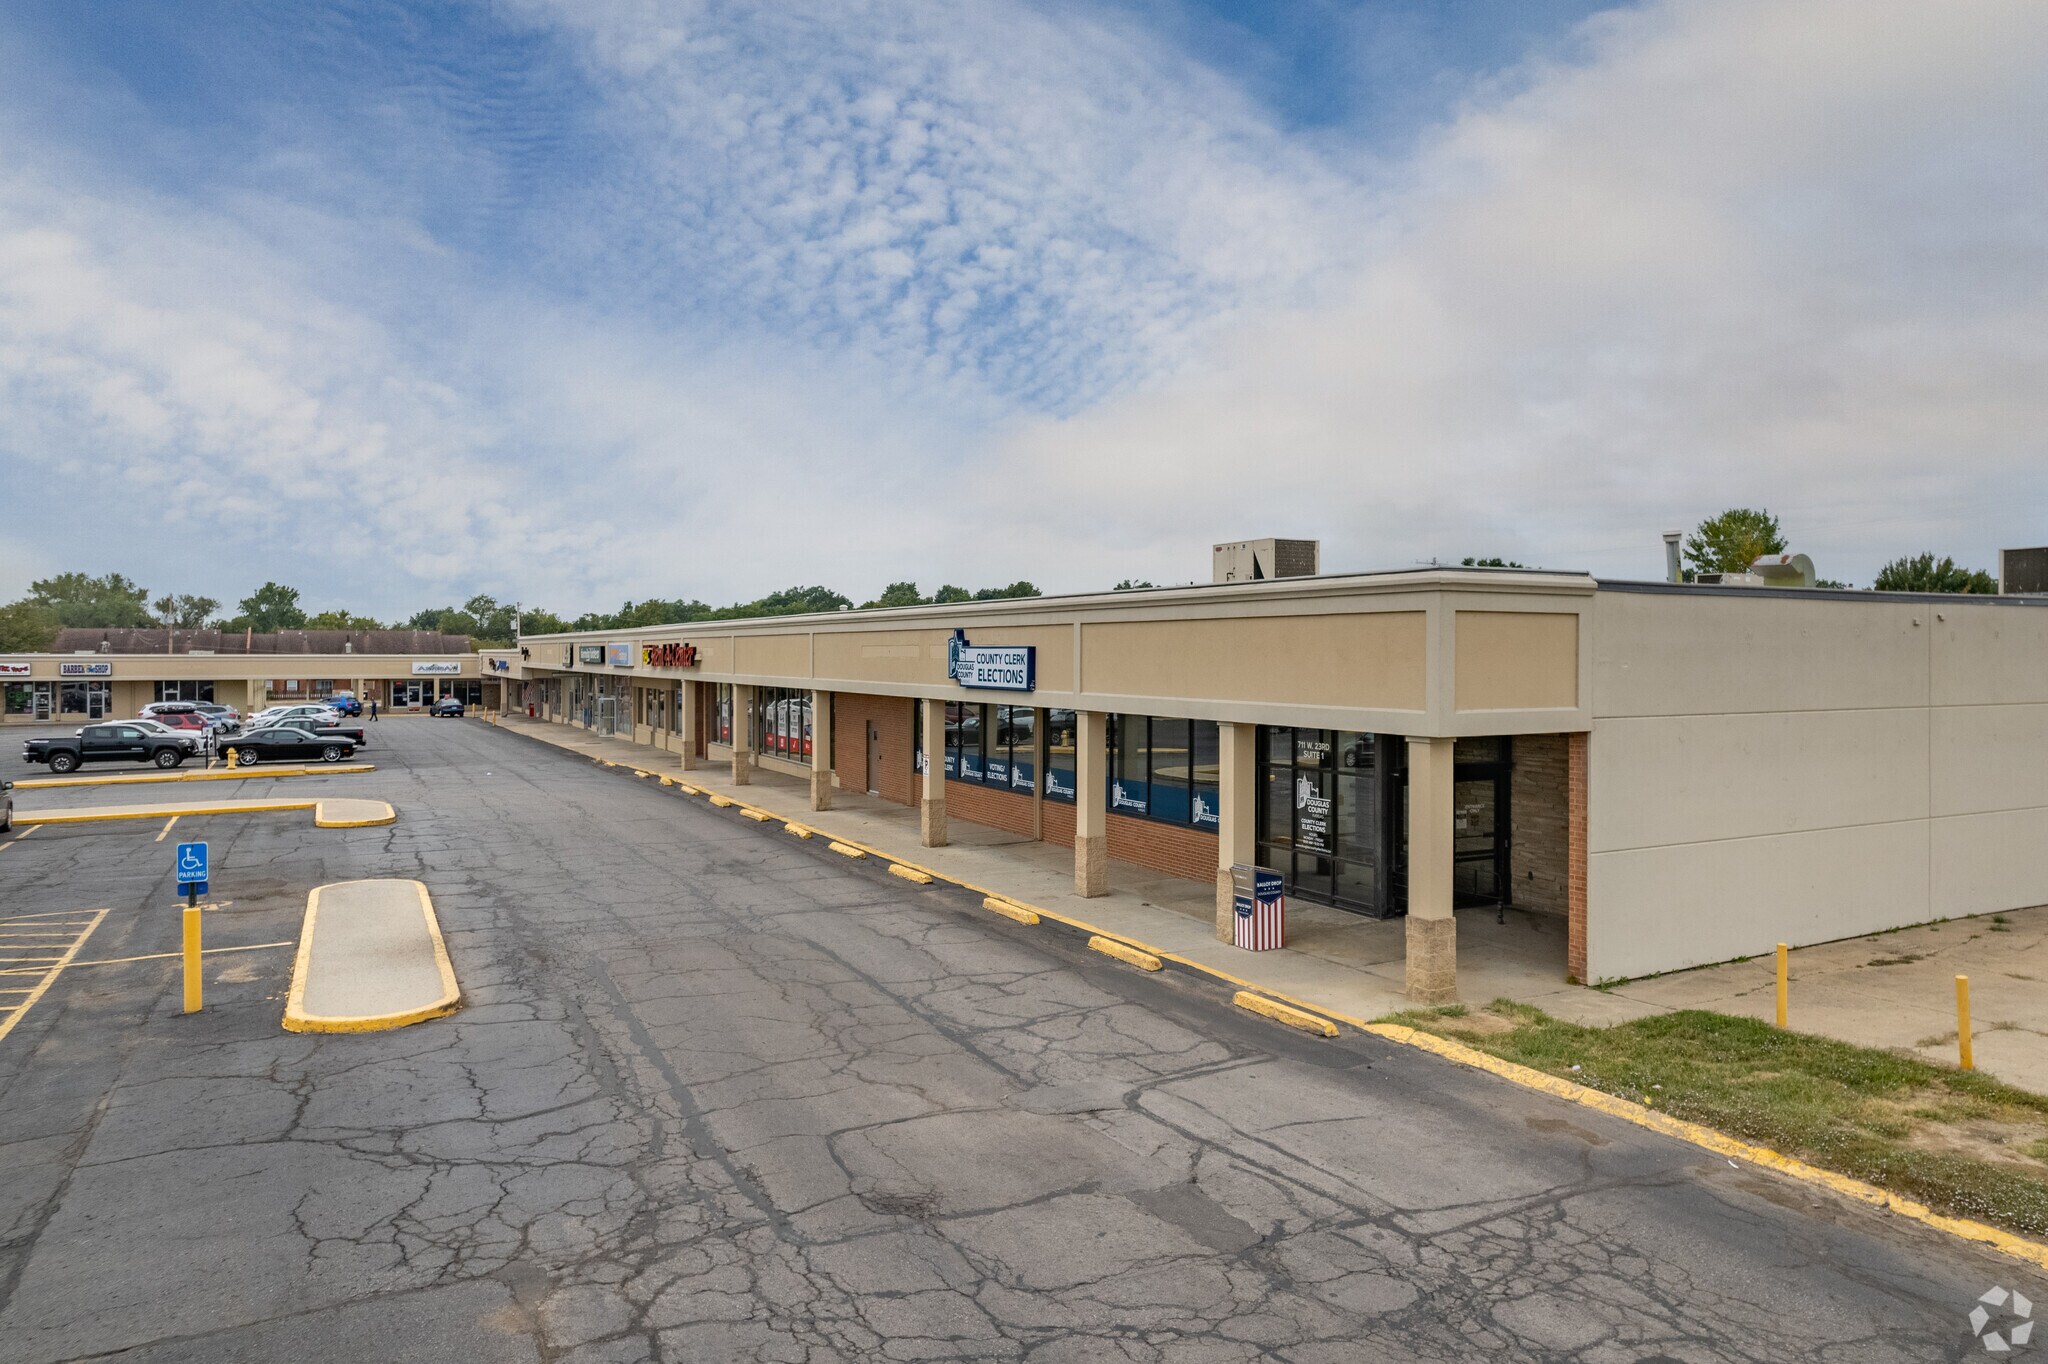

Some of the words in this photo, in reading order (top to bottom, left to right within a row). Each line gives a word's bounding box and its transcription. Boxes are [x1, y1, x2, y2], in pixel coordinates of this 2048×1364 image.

[976, 654, 1003, 664] COUNTY
[1004, 654, 1026, 665] CLERK
[978, 668, 1024, 684] ELECTIONS
[1306, 741, 1314, 750] W.
[1314, 742, 1330, 750] 23RD
[1304, 750, 1320, 760] SUITE
[944, 756, 955, 764] OUNTY
[986, 772, 1008, 782] ELECTIONS
[1306, 800, 1330, 808] DOUGLAS
[1308, 806, 1328, 814] COUNTY
[1200, 814, 1216, 822] DOUGLAS
[1302, 824, 1326, 834] ELECTIONS
